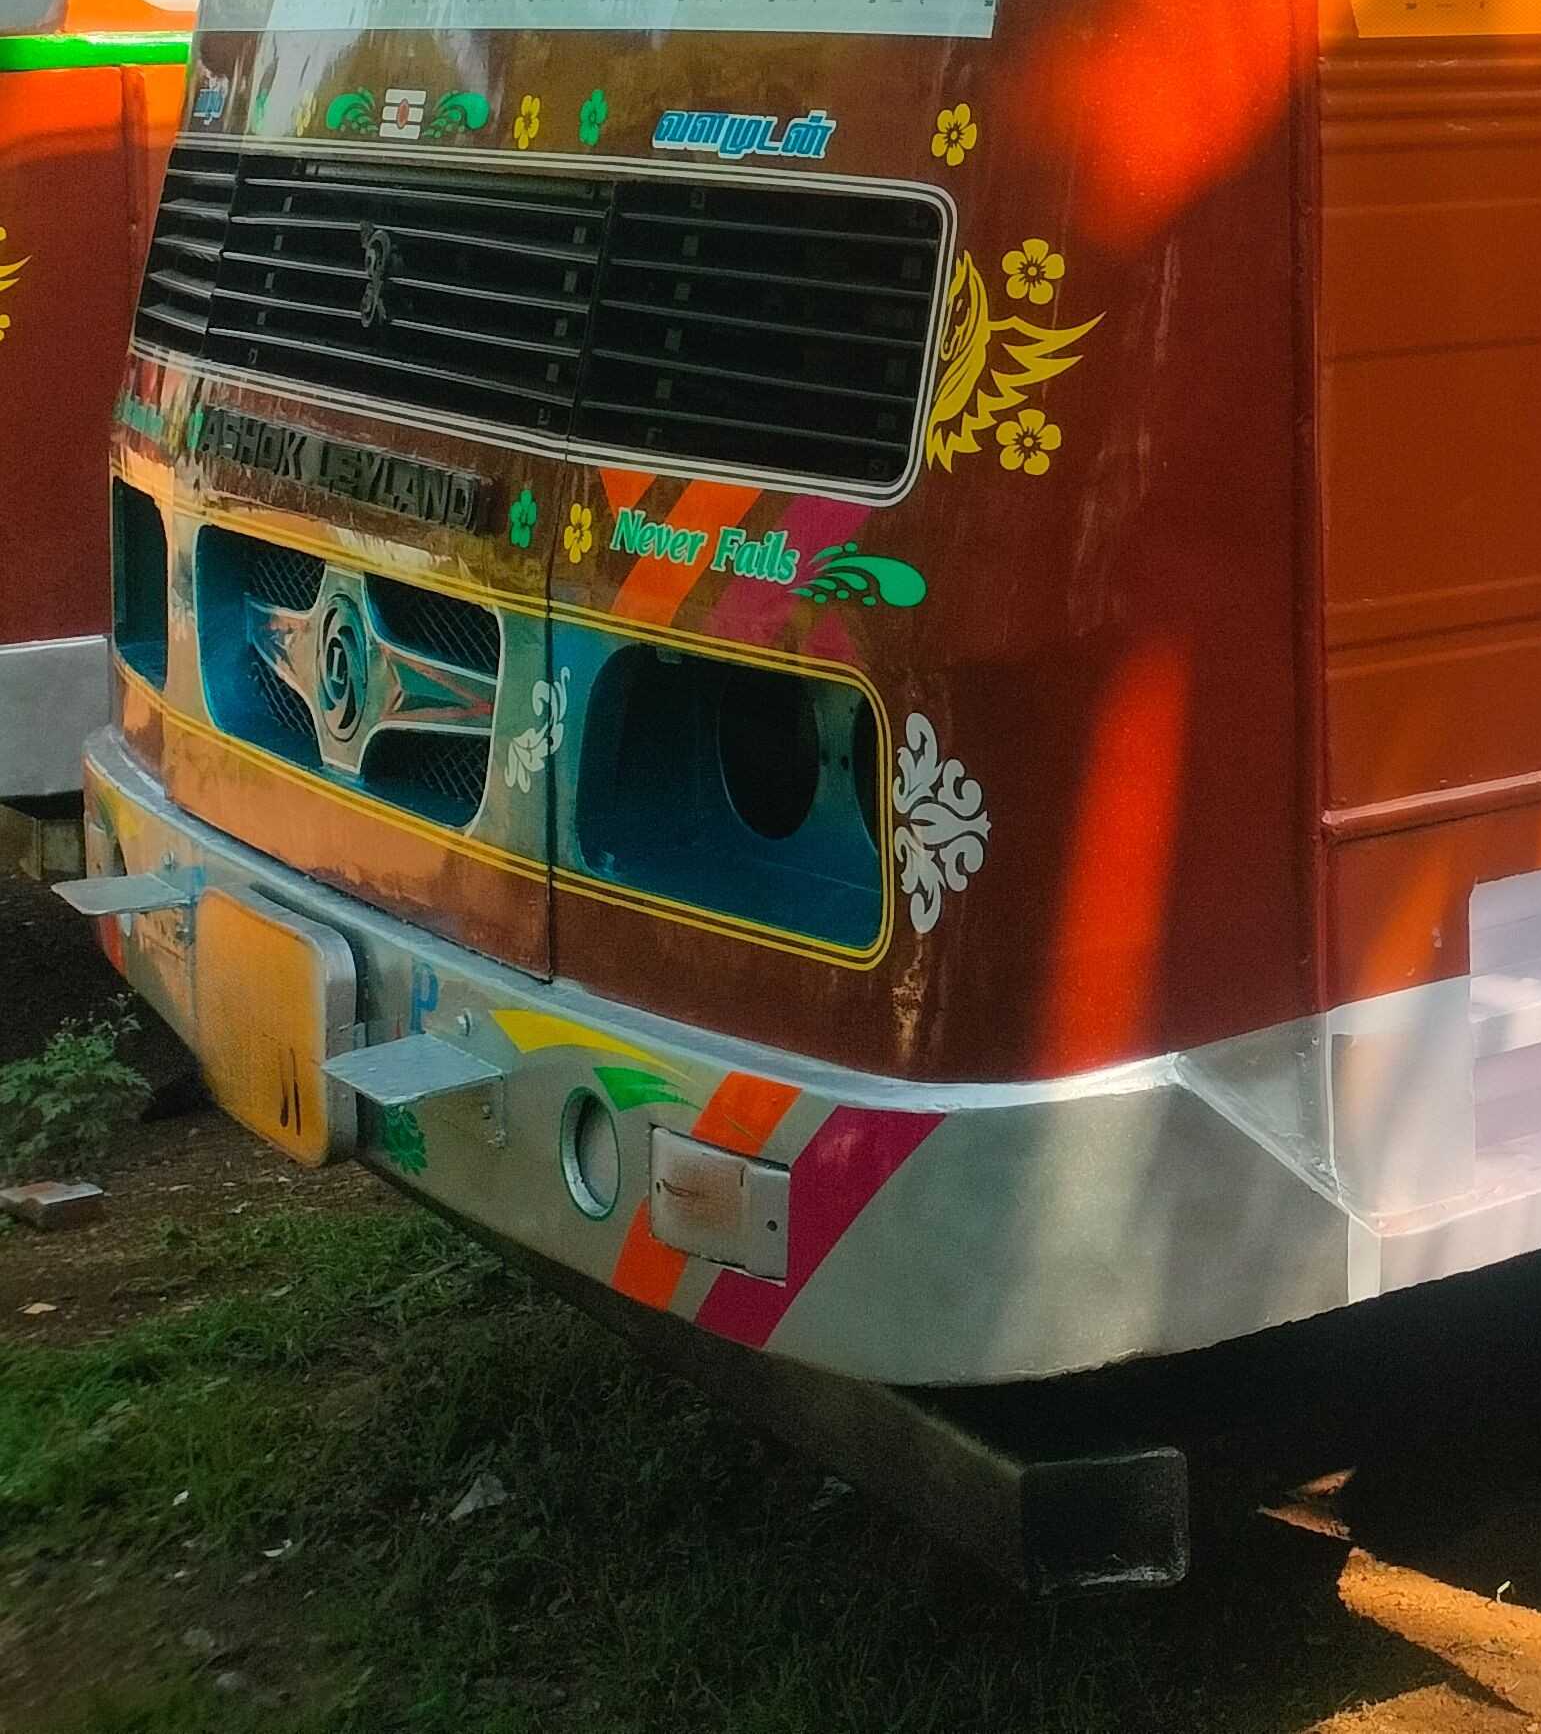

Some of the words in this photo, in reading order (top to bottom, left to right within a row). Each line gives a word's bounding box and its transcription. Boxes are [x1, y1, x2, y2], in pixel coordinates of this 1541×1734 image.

[200, 408, 306, 480] ASHOK
[320, 438, 481, 534] LEYLAND
[609, 506, 708, 566] Never
[710, 525, 800, 586] Fails
